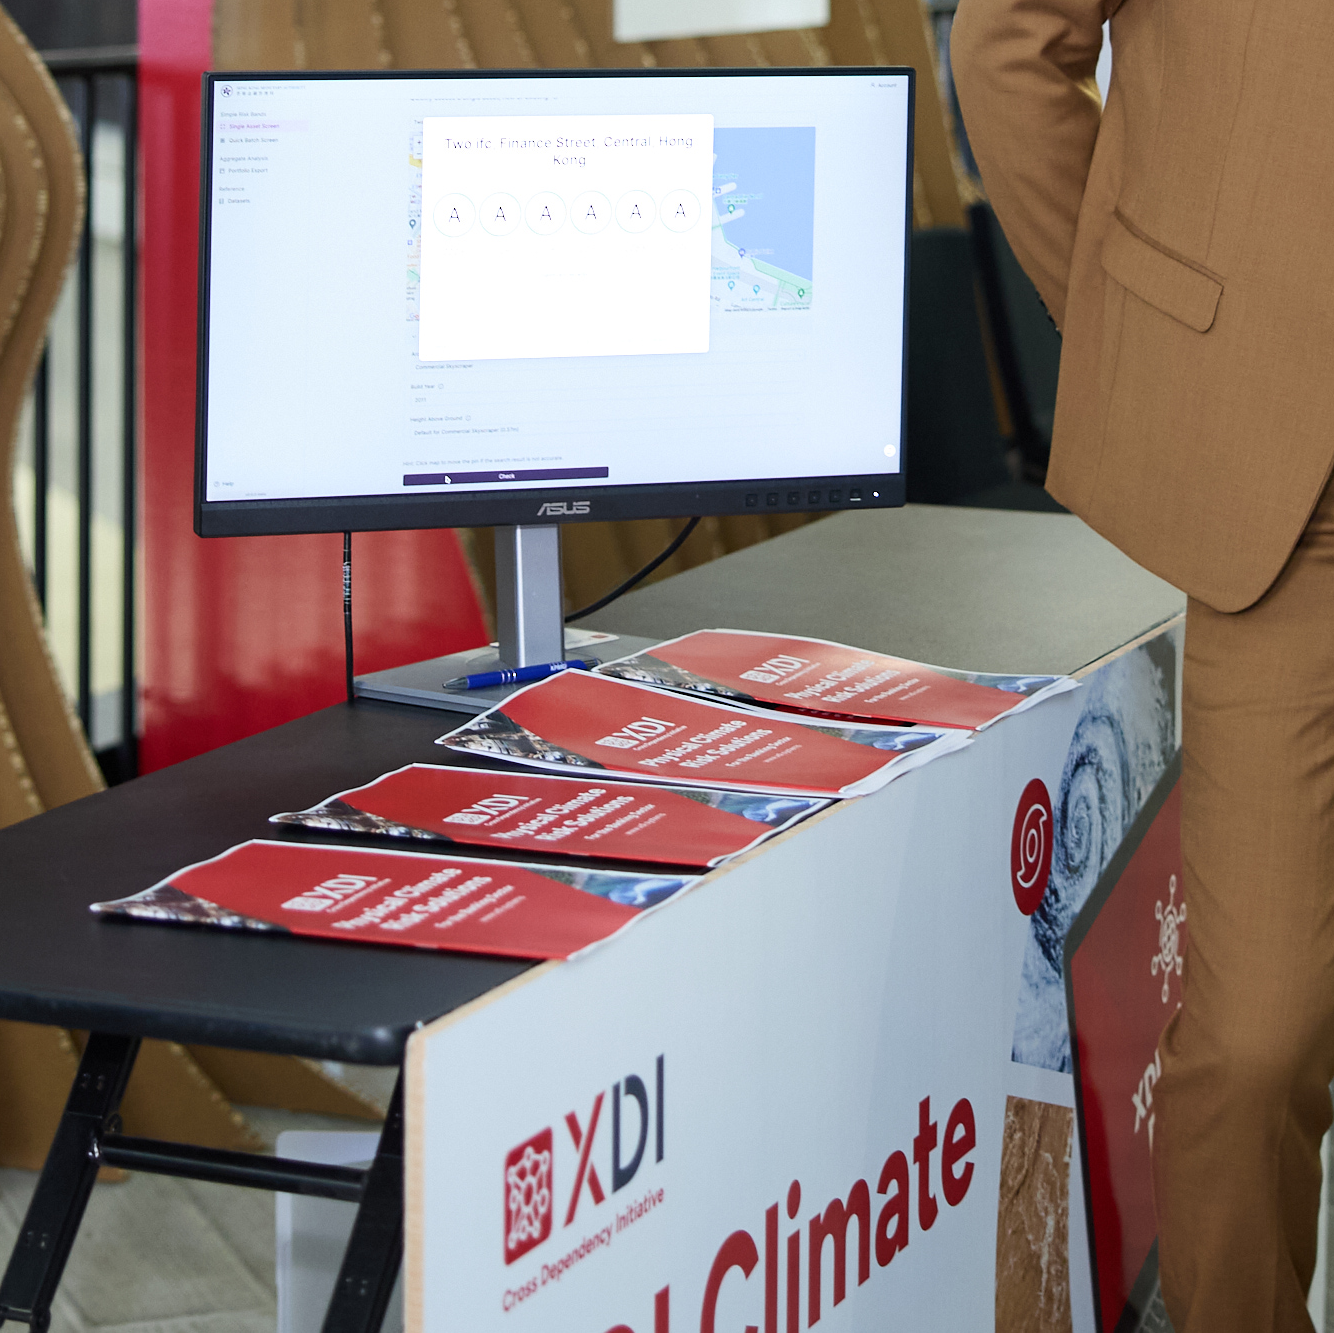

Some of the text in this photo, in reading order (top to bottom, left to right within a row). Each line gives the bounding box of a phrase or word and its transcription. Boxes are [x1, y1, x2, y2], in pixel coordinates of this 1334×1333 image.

[445, 137, 472, 149] Two
[500, 137, 552, 149] Finance
[659, 135, 693, 149] Hong
[553, 154, 586, 168] Kong
[449, 203, 686, 222] A A A A A A
[498, 472, 516, 480] Check
[537, 500, 591, 516] ASUS
[753, 653, 811, 676] XDI
[782, 677, 839, 700] Physical
[825, 657, 880, 681] Climate
[820, 690, 858, 703] Risk
[843, 666, 904, 692] Solutions
[611, 715, 676, 741] XDI
[637, 719, 747, 767] Physical Climate
[678, 753, 721, 768] Risk
[705, 728, 773, 755] Solutions
[460, 793, 529, 815] XDI
[489, 787, 607, 839] Physical Climate
[533, 825, 579, 841] Risk
[562, 795, 635, 827] Solutions
[301, 873, 377, 900] XDI
[331, 895, 409, 929] Physical
[392, 867, 462, 898] Climate
[378, 910, 429, 930] Risk
[411, 875, 492, 913] Solutions
[563, 1052, 665, 1228] XDI
[699, 1095, 976, 1333] Climate
[502, 1186, 665, 1313] Cross Dependency Initiative
